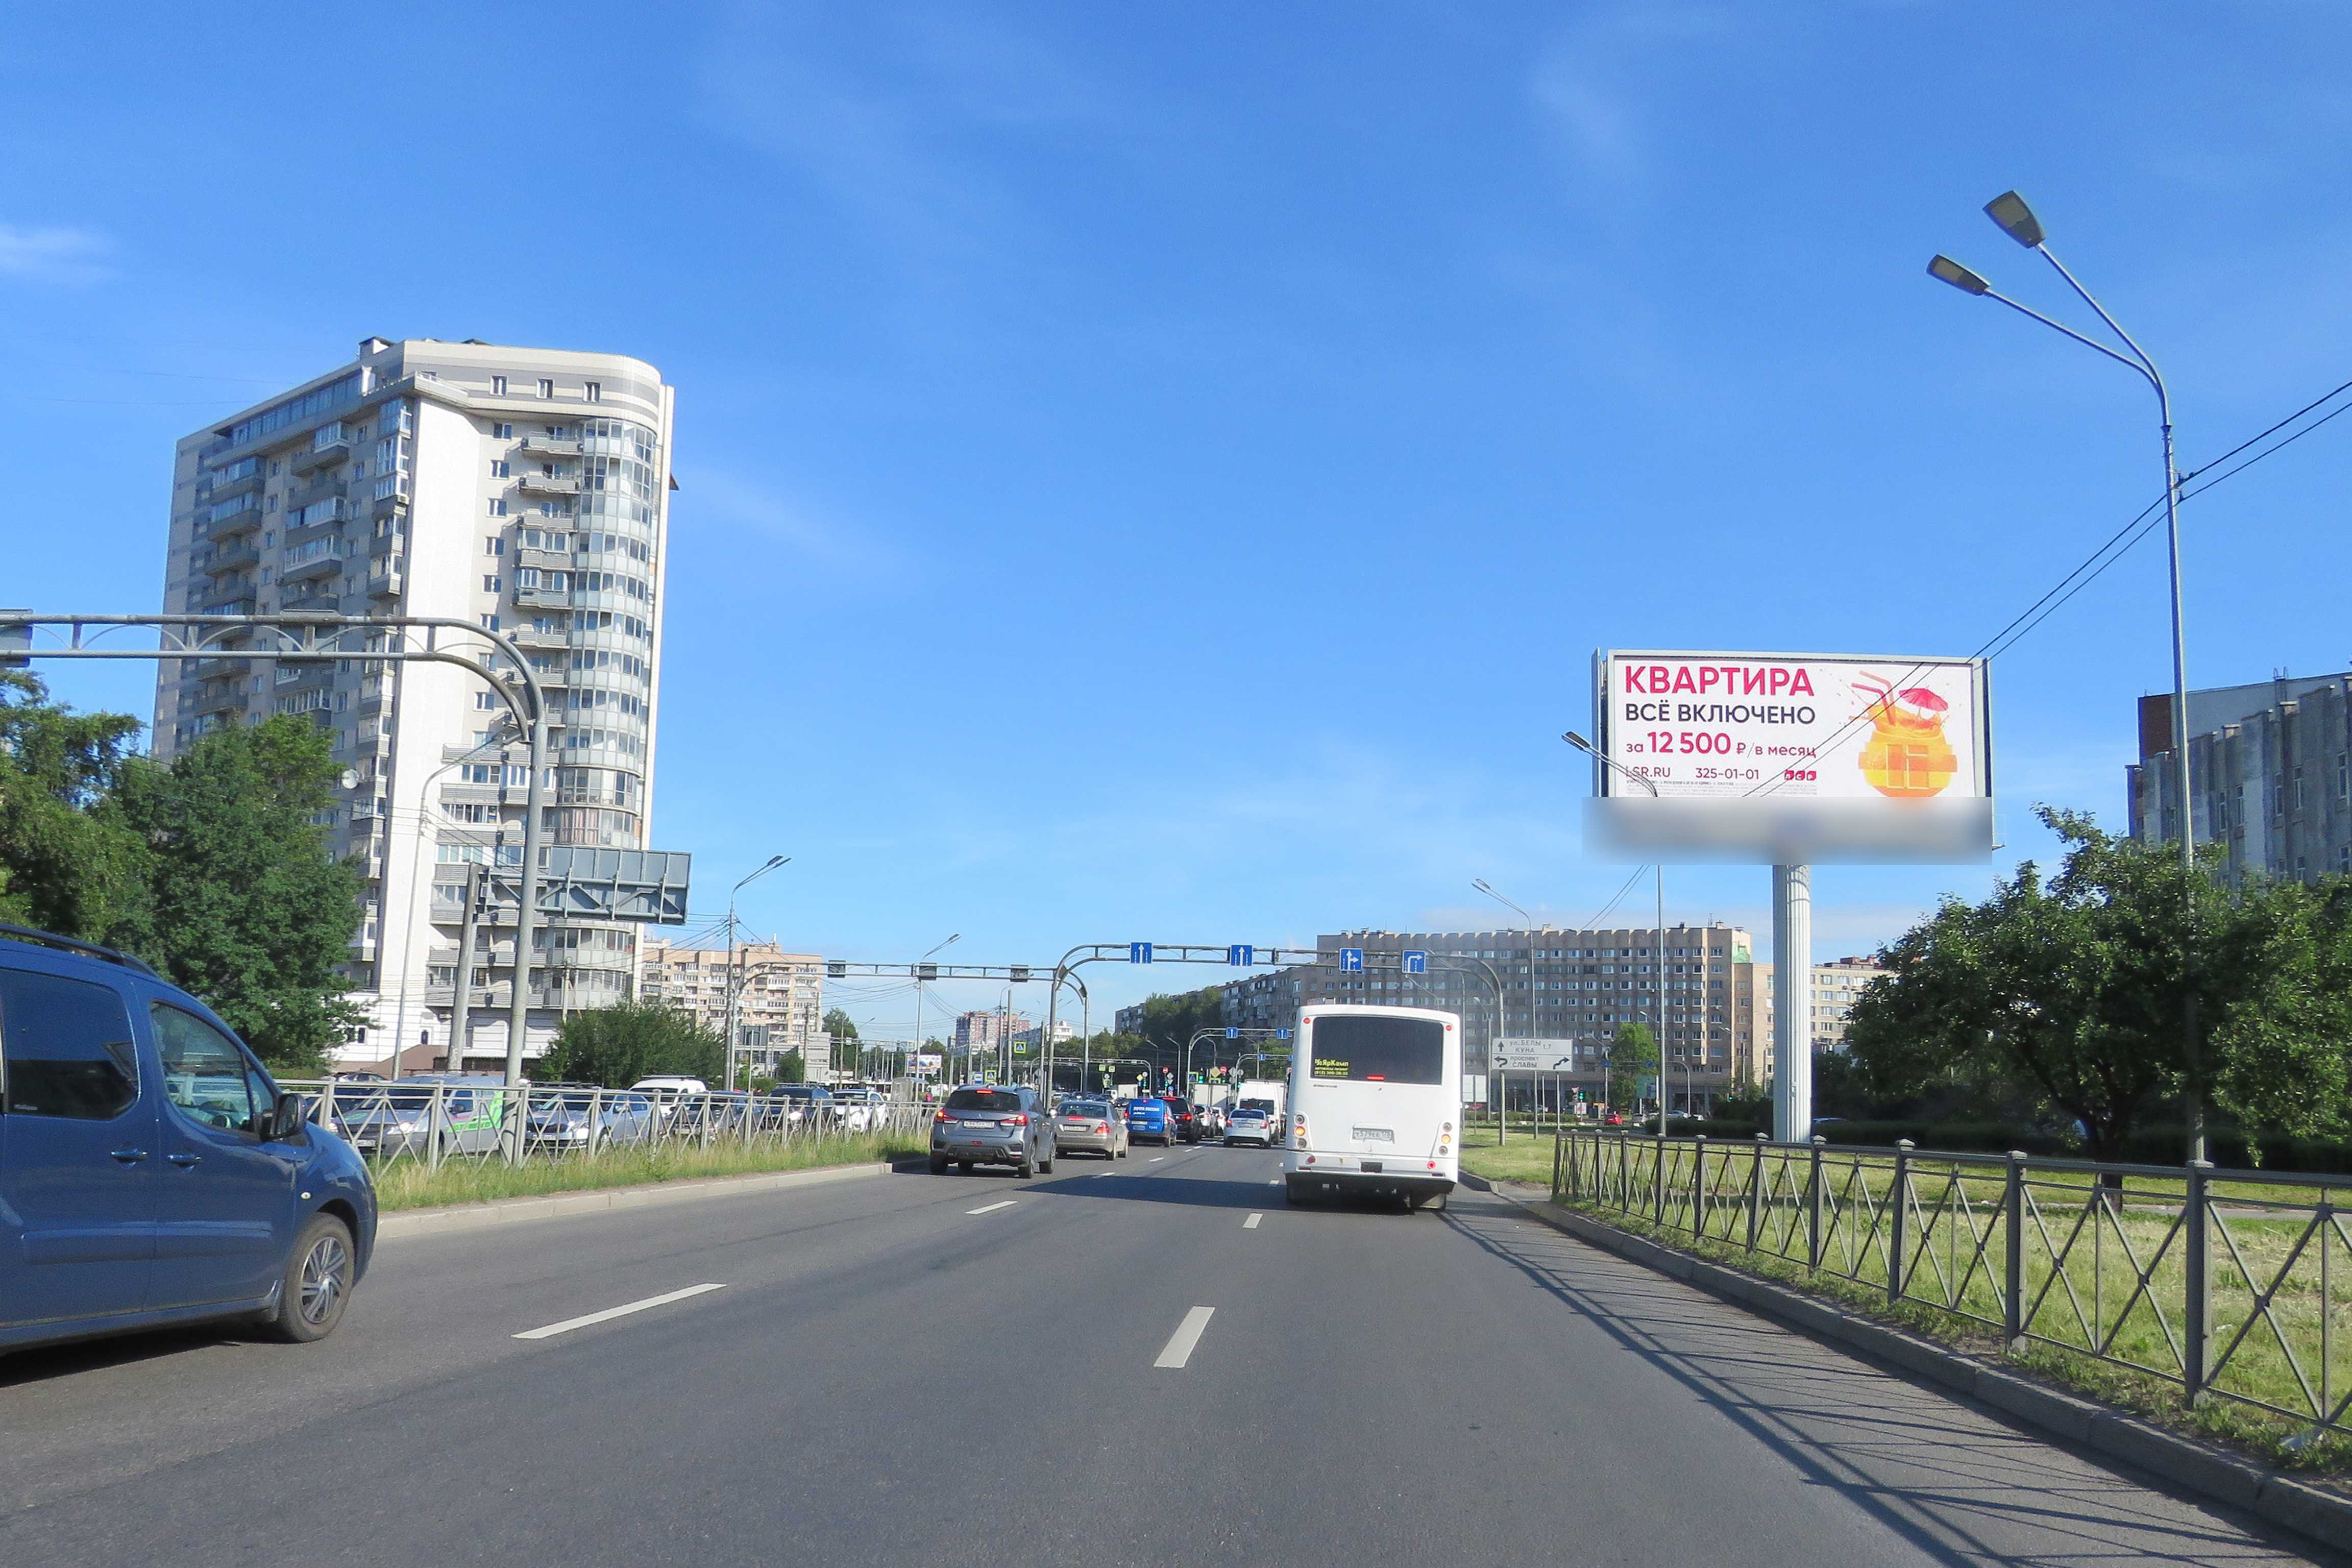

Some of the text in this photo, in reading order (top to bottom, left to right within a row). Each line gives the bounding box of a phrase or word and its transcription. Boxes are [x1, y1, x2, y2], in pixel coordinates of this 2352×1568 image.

[1626, 666, 1815, 696] КВАРТИРА
[1626, 700, 1816, 725] ВСЁ ВКЛЮЧЕНО
[1626, 744, 1644, 753] за
[1768, 746, 1816, 758] месяц
[1696, 768, 1759, 780] 325-01-01
